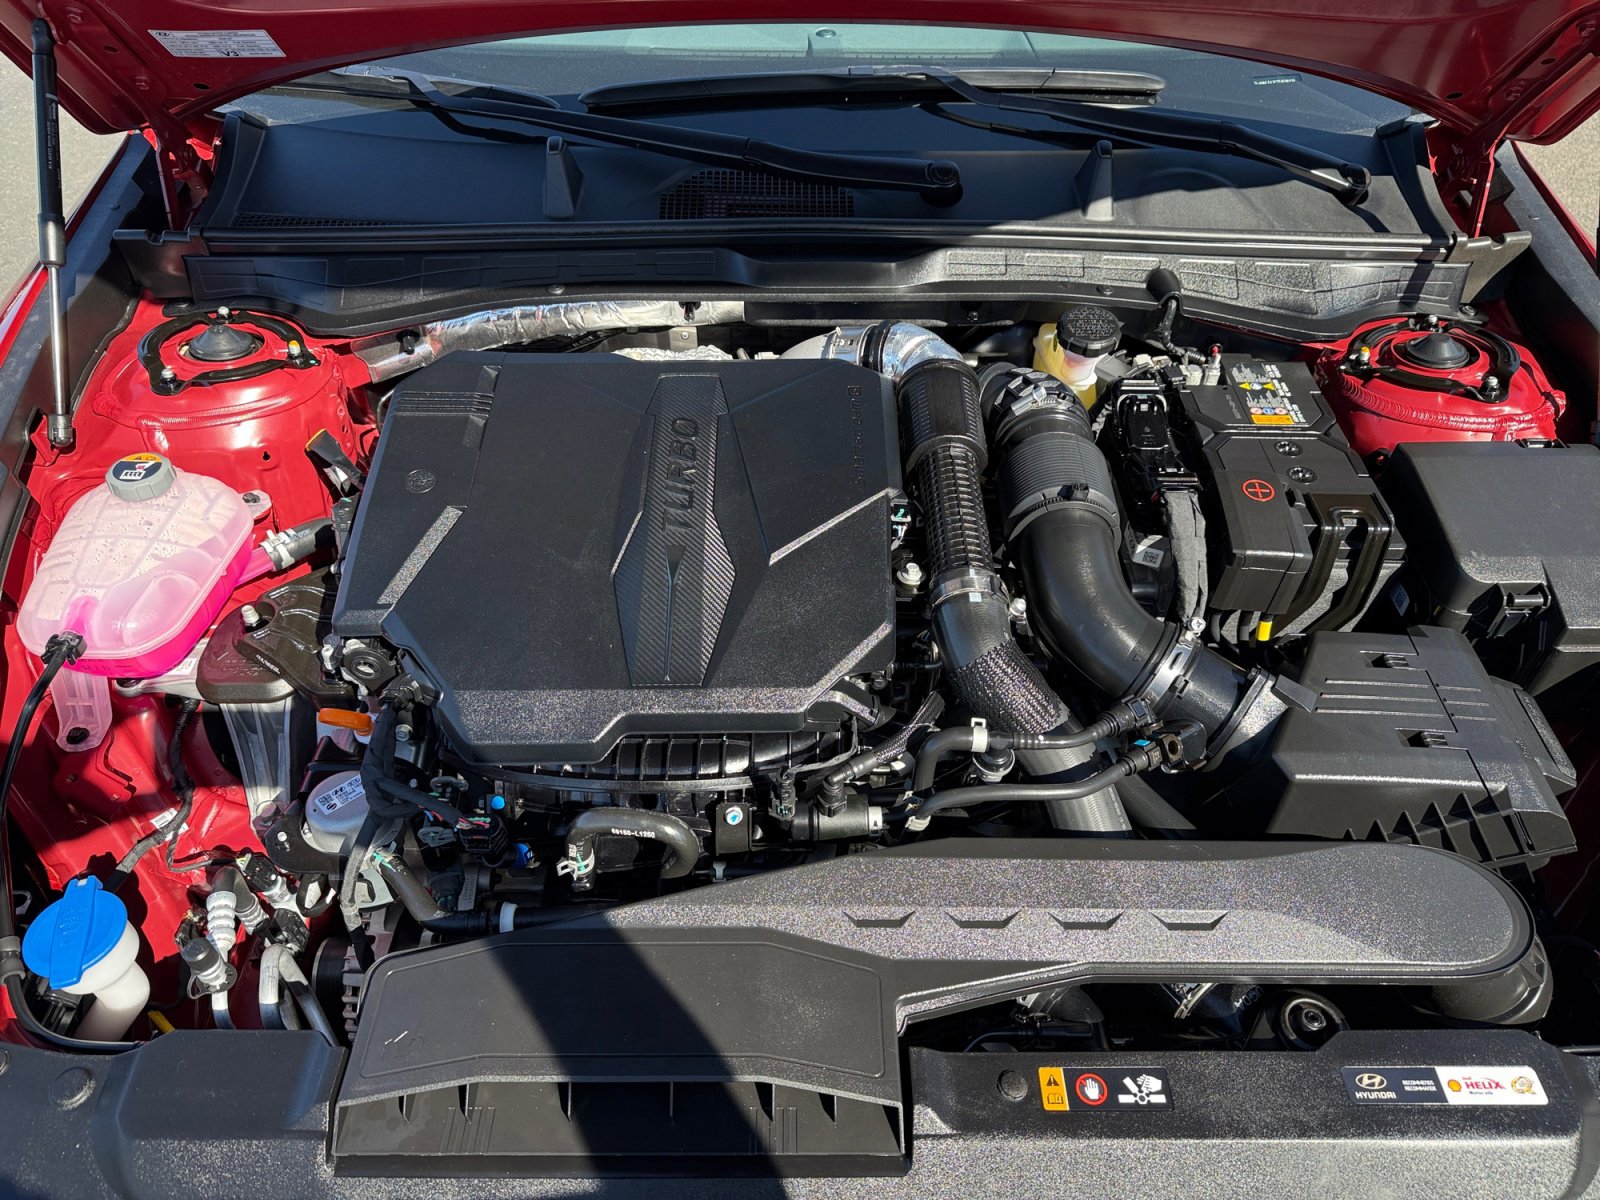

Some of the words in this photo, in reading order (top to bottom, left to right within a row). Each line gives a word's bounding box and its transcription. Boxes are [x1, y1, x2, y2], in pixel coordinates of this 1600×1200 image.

[662, 418, 699, 534] TURBO
[1465, 1081, 1505, 1089] HELIX
[1355, 1091, 1397, 1099] HYUNDAI
